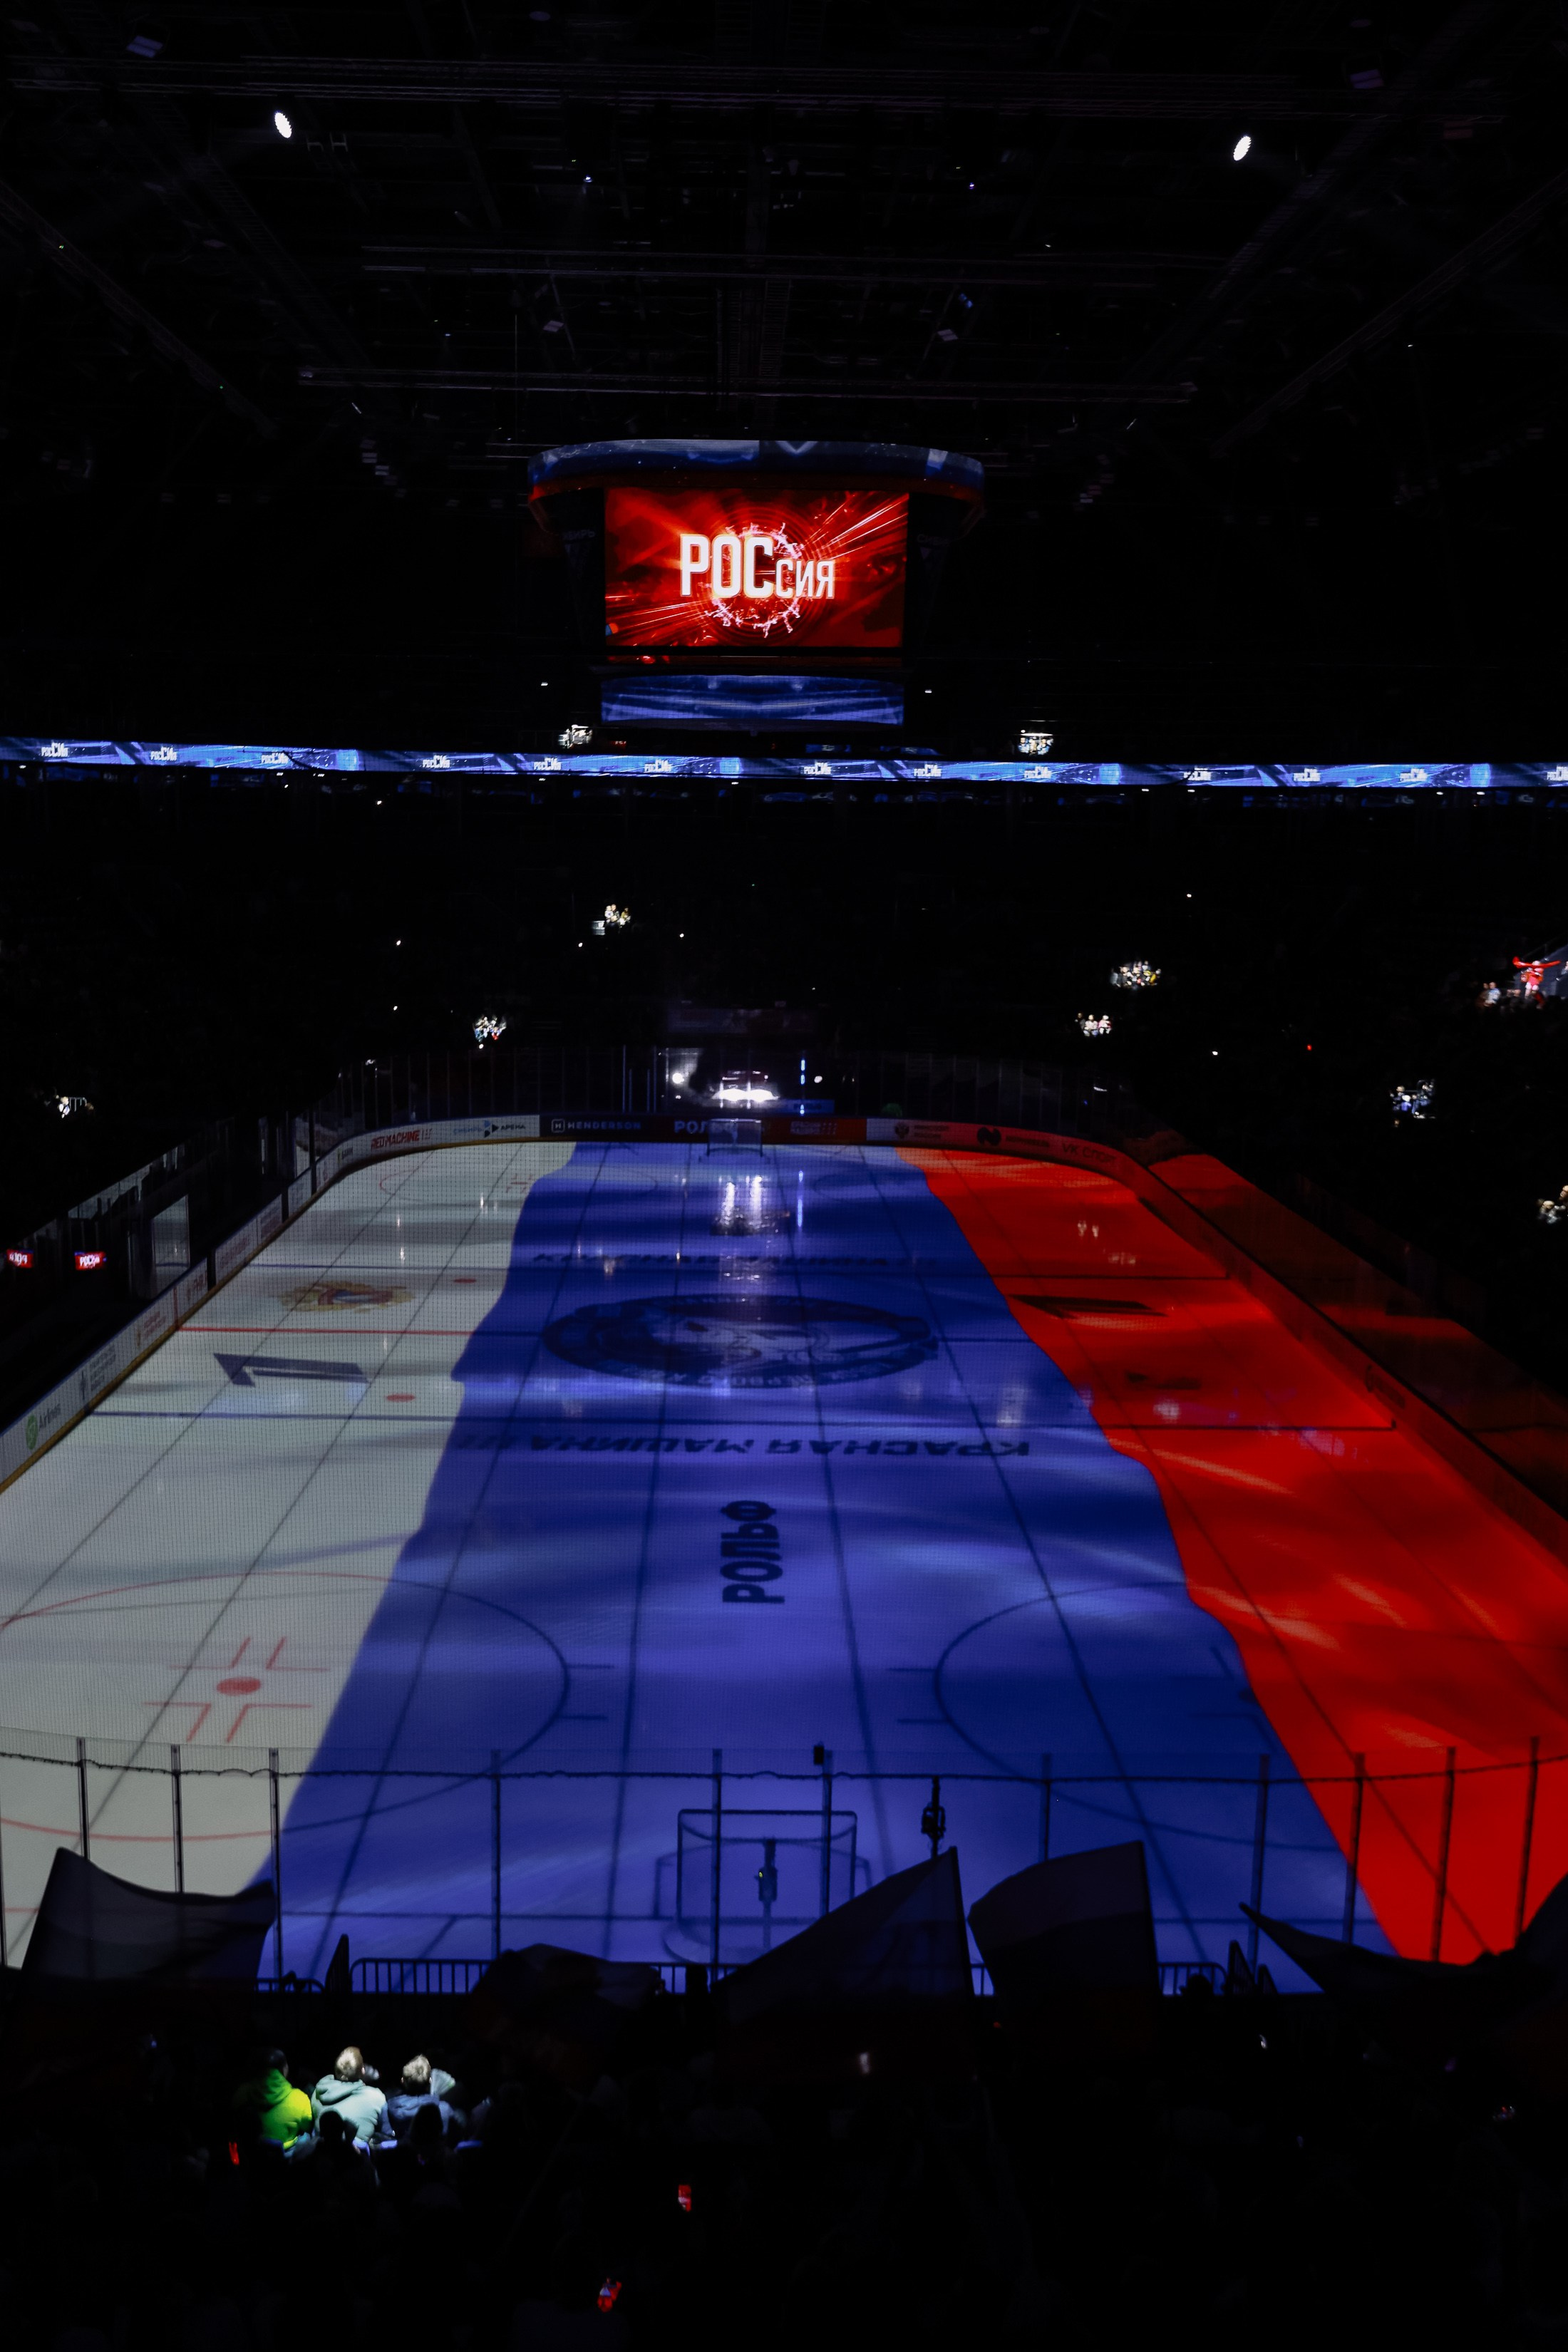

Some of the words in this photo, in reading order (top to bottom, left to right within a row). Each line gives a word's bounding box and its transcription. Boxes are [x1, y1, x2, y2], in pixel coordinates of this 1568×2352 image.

[567, 1121, 641, 1130] HENDERSON
[531, 1435, 755, 1454] МАШИНА
[766, 1439, 1031, 1457] КРАСНАЯ
[720, 1500, 785, 1604] РОЛЬФ
